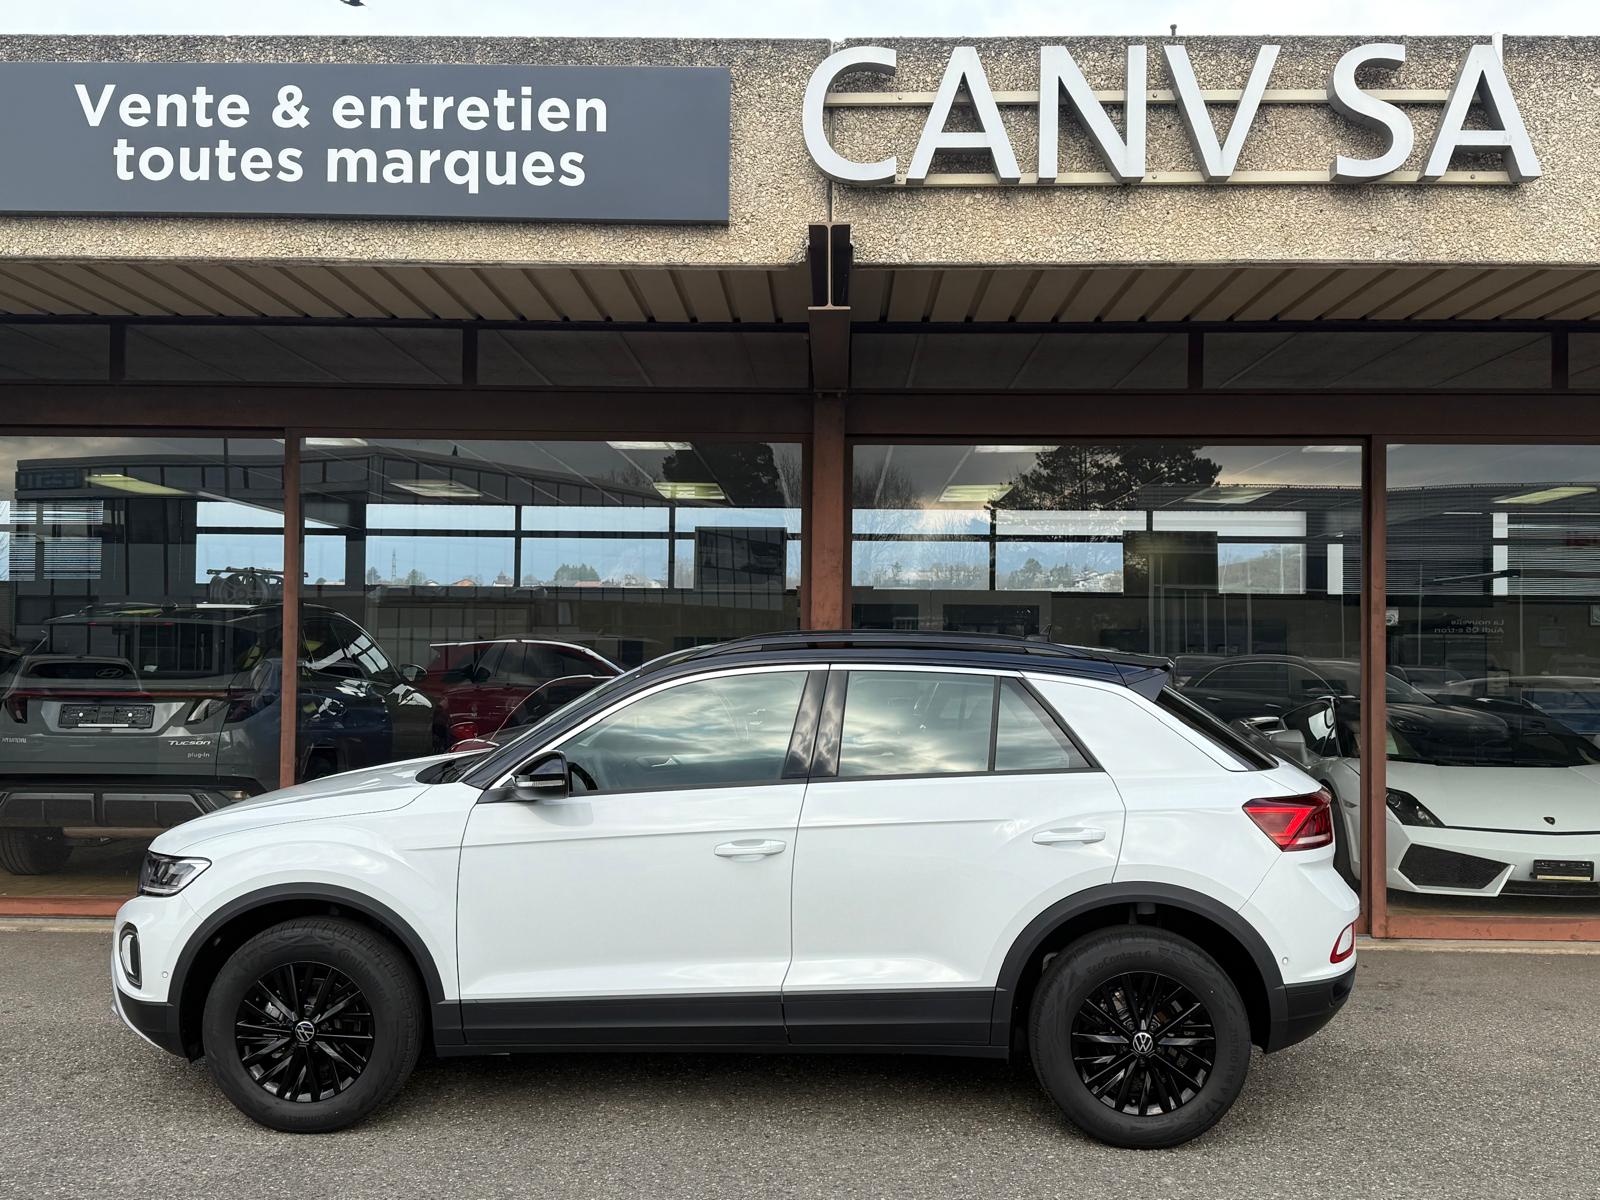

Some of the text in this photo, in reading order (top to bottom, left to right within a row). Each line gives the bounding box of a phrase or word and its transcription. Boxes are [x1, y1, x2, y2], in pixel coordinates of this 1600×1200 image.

[74, 84, 607, 132] Vente & entretien
[803, 44, 1541, 184] CANV SA
[113, 138, 586, 194] toutes marques
